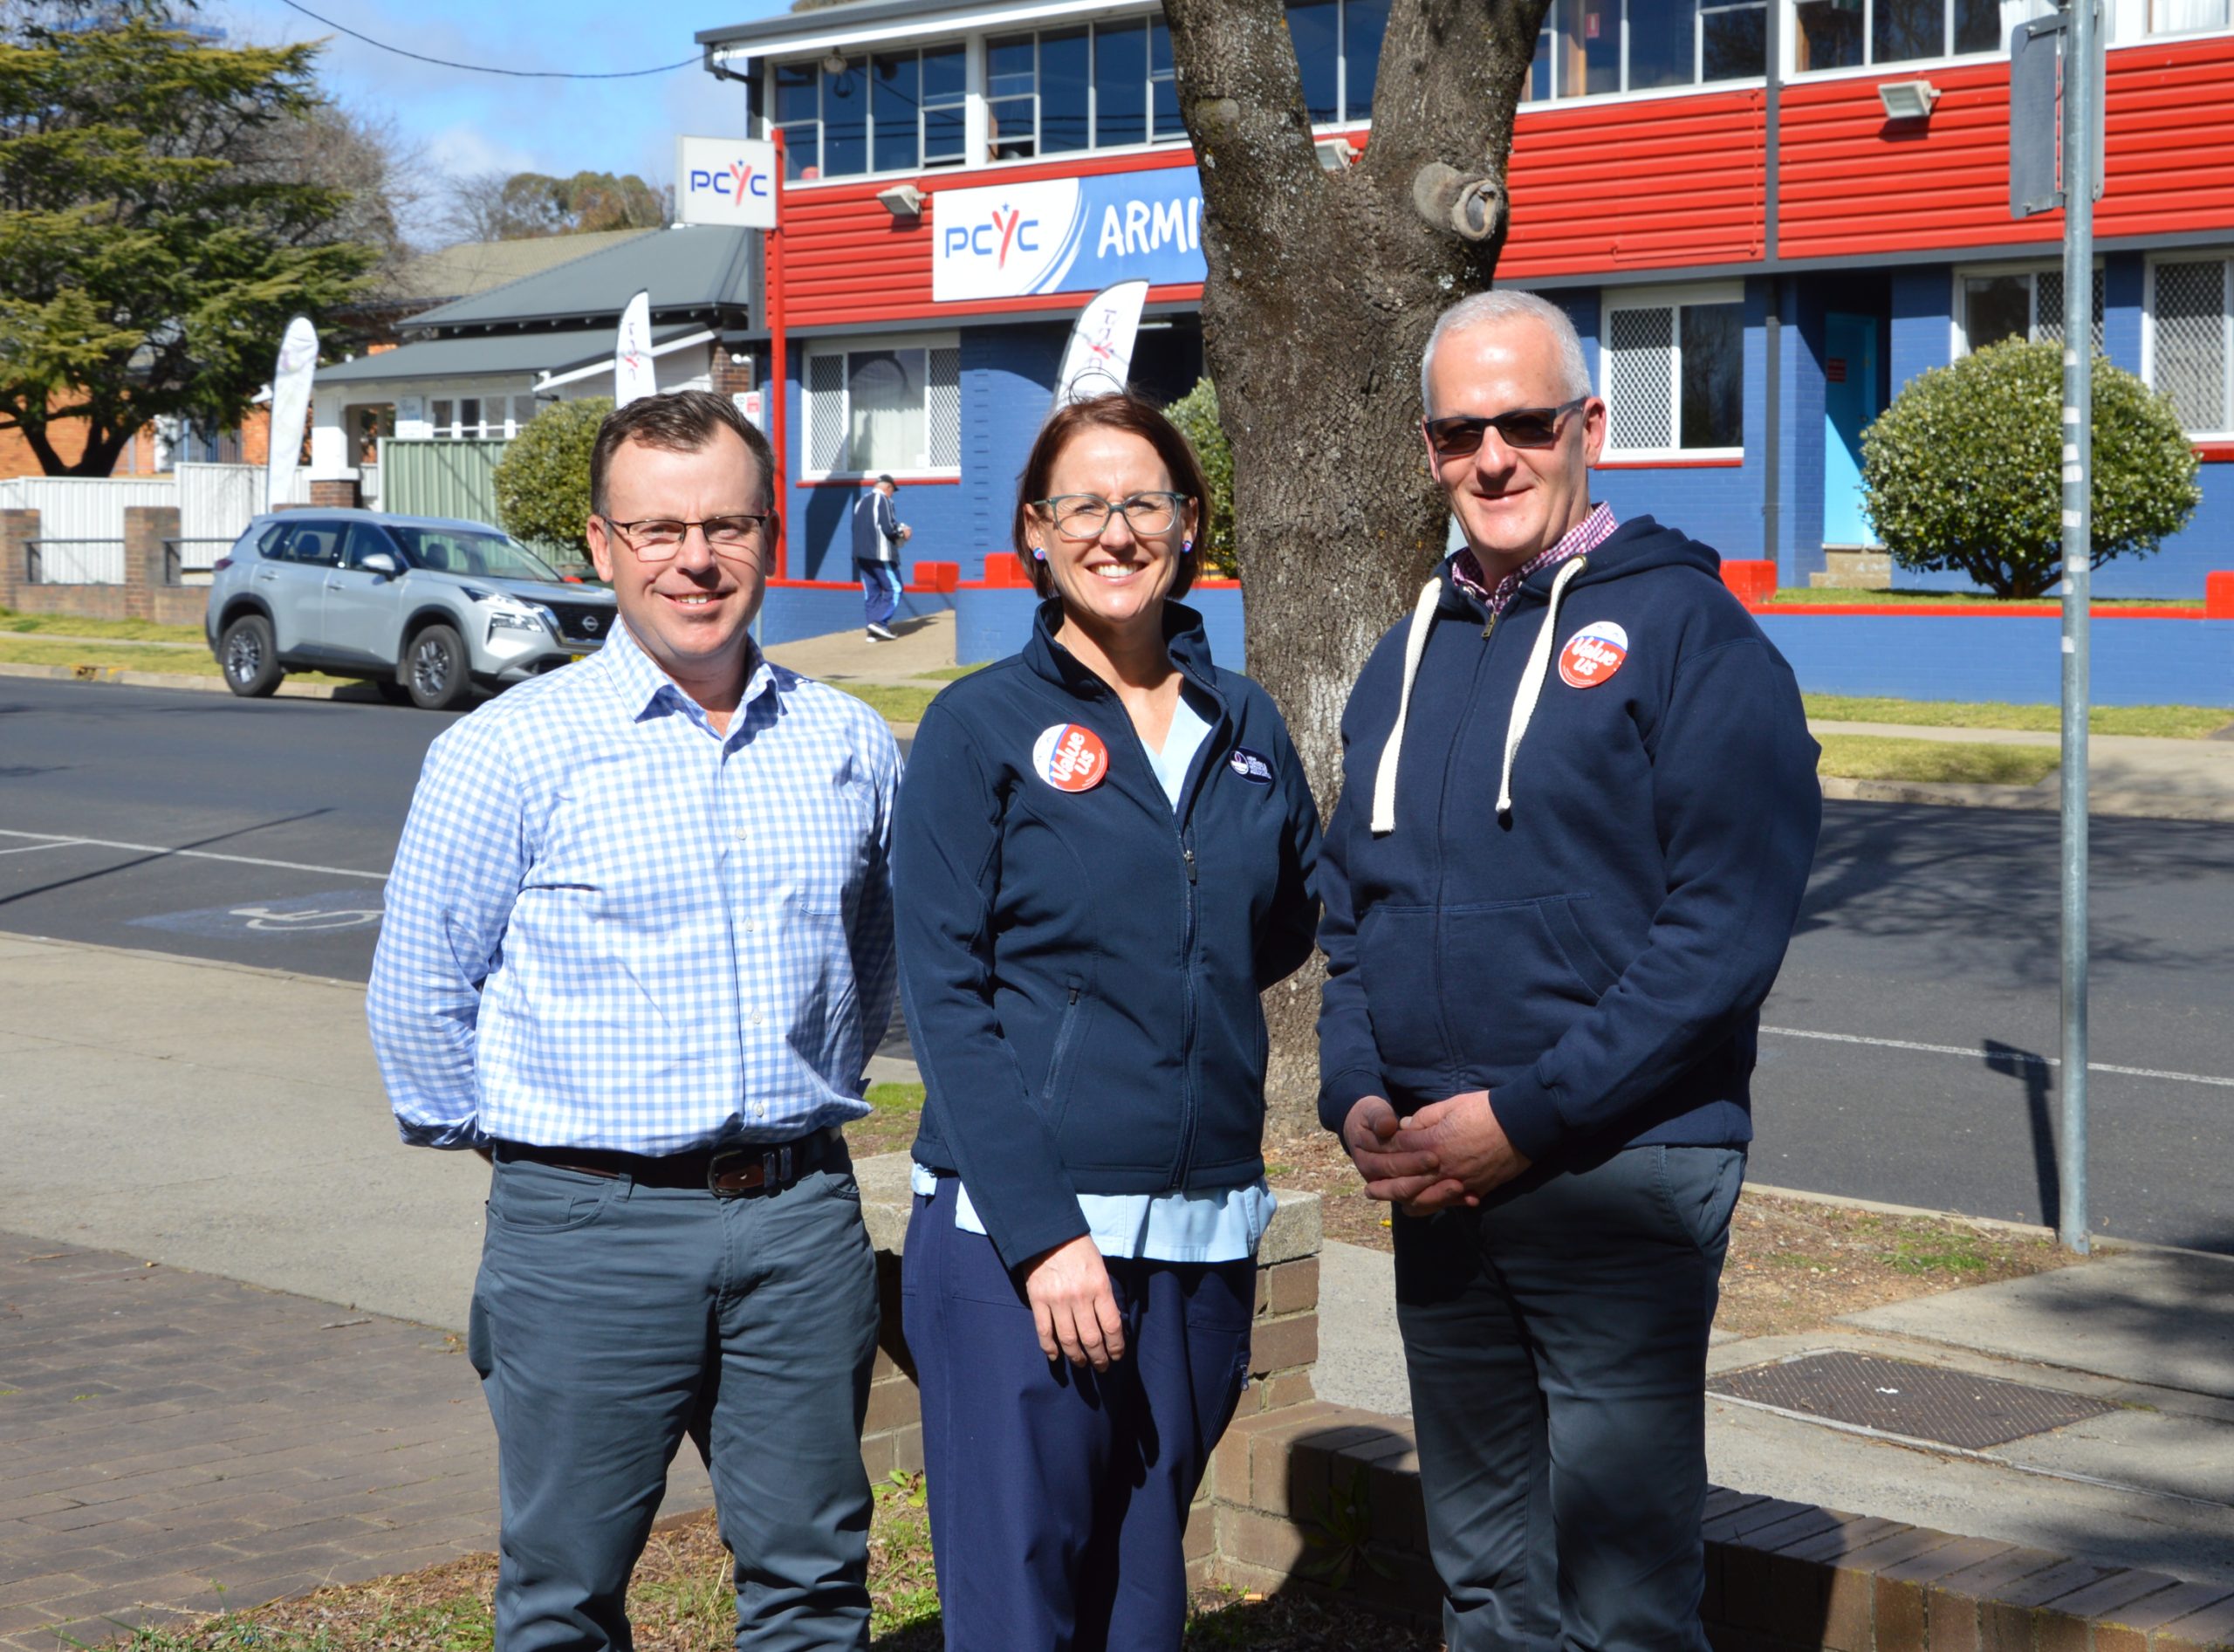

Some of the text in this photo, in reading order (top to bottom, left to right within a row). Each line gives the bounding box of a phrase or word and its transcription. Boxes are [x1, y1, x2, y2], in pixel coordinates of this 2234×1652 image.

[690, 163, 767, 207] PCYC
[945, 196, 1204, 271] PCYC ARMI
[1572, 636, 1617, 666] Value
[1573, 657, 1597, 676] us
[1049, 731, 1086, 783] Value
[1073, 749, 1096, 776] us
